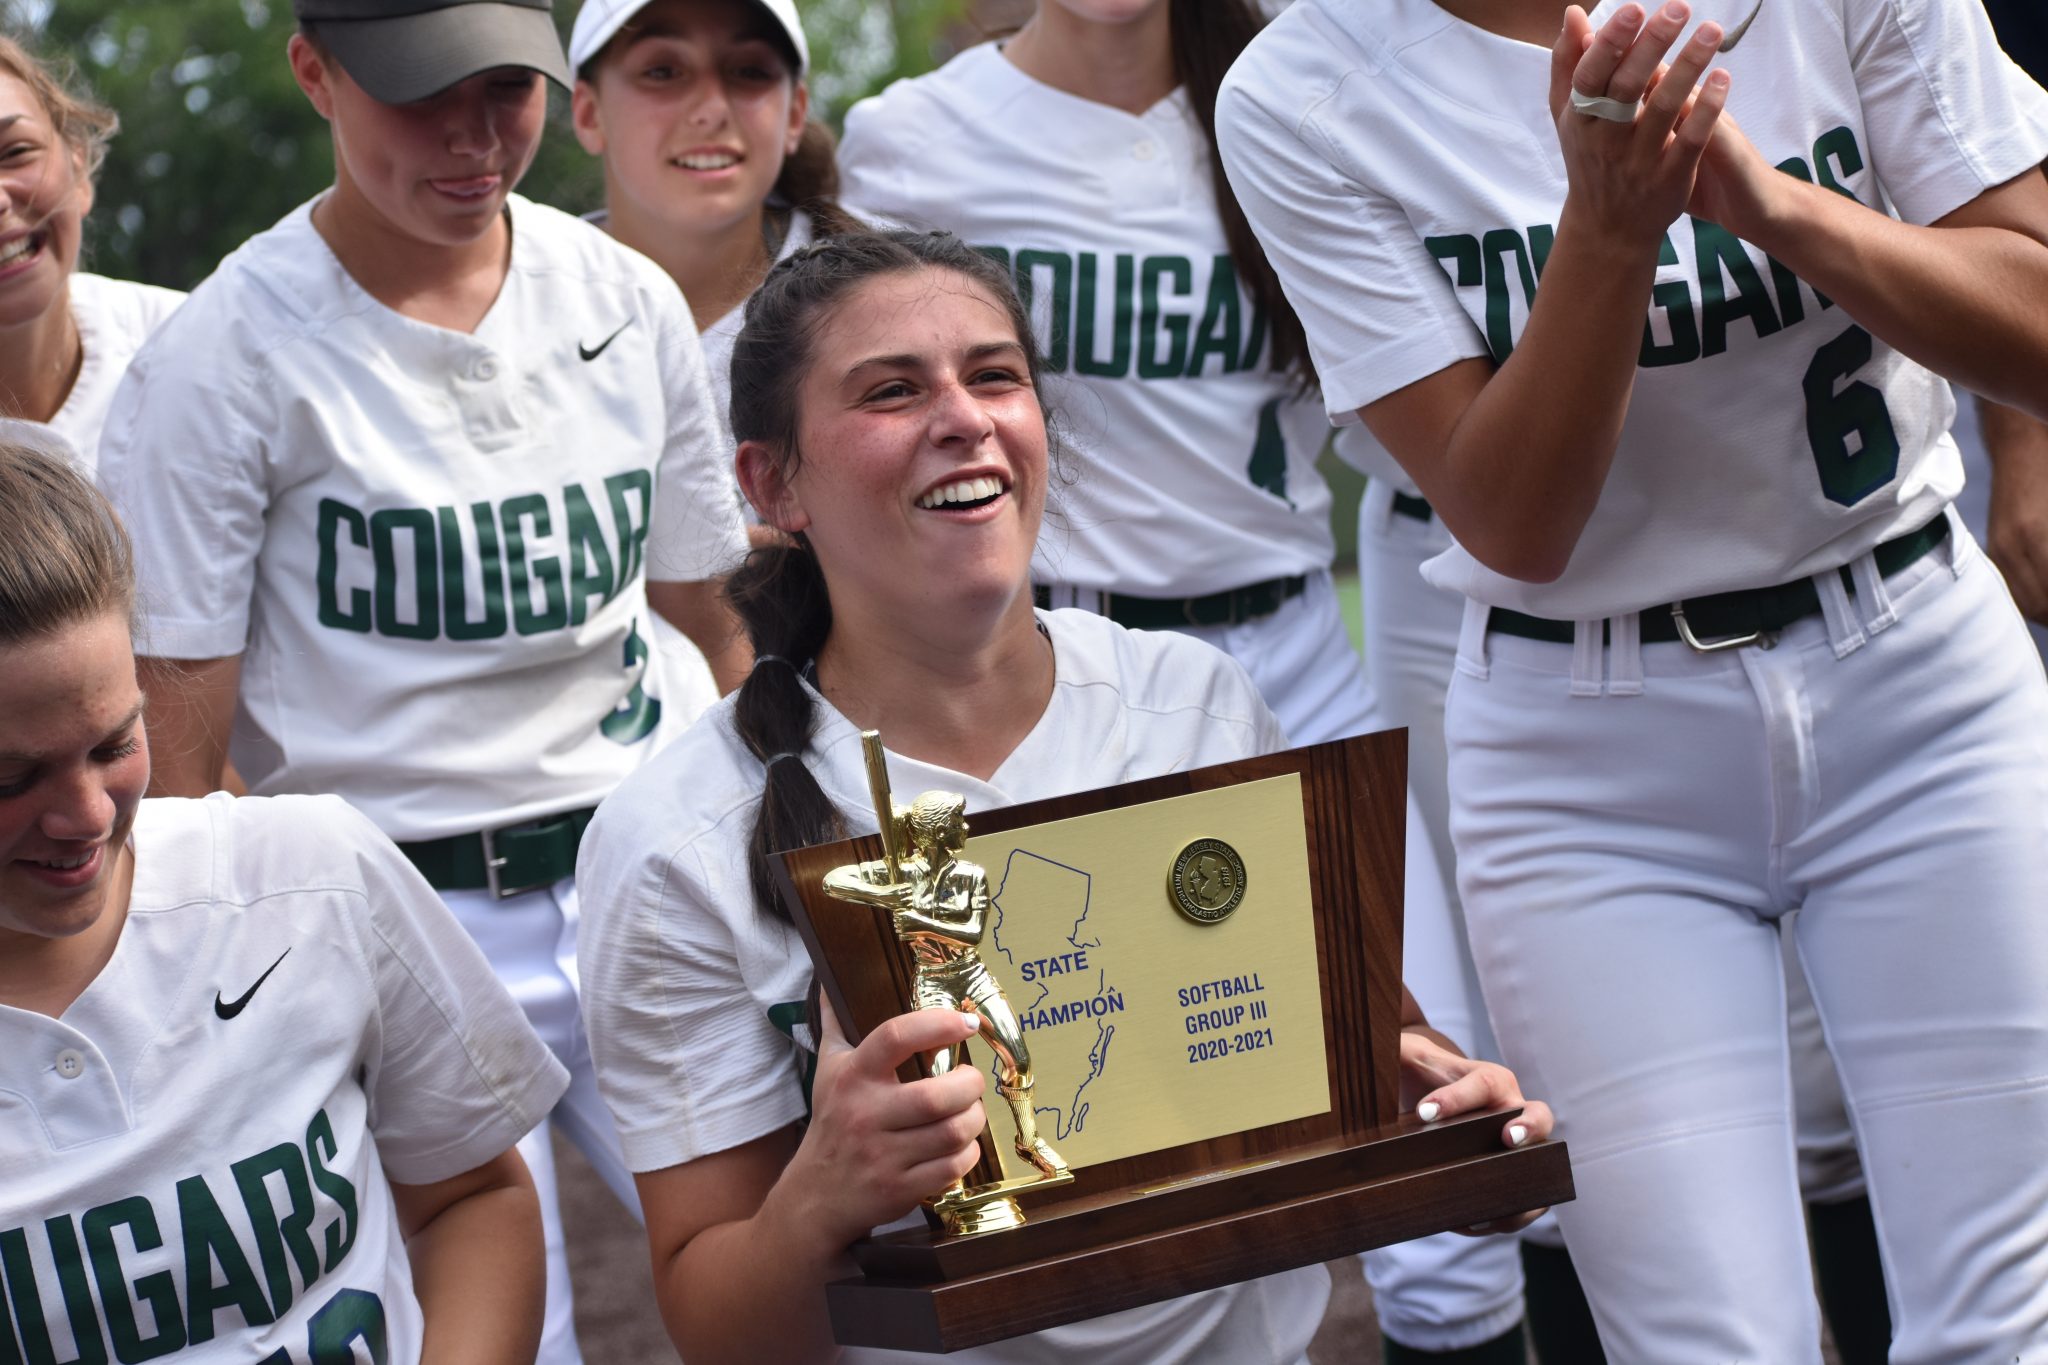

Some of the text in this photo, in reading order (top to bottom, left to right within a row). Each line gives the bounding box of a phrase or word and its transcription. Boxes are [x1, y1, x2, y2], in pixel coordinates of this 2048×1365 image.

[972, 246, 1267, 379] OUGA
[1802, 323, 1900, 506] 6
[316, 461, 660, 641] COUGAR
[1177, 841, 1235, 872] NEW JERSEY STATE
[1219, 888, 1243, 915] ATHLETIC
[1021, 951, 1088, 981] STATE
[1178, 973, 1264, 1008] SOFTBALL
[1019, 992, 1124, 1032] HAMPION
[1185, 1000, 1268, 1035] GROUP III
[1187, 1028, 1274, 1064] 2020-2021
[0, 1108, 358, 1365] UGARS
